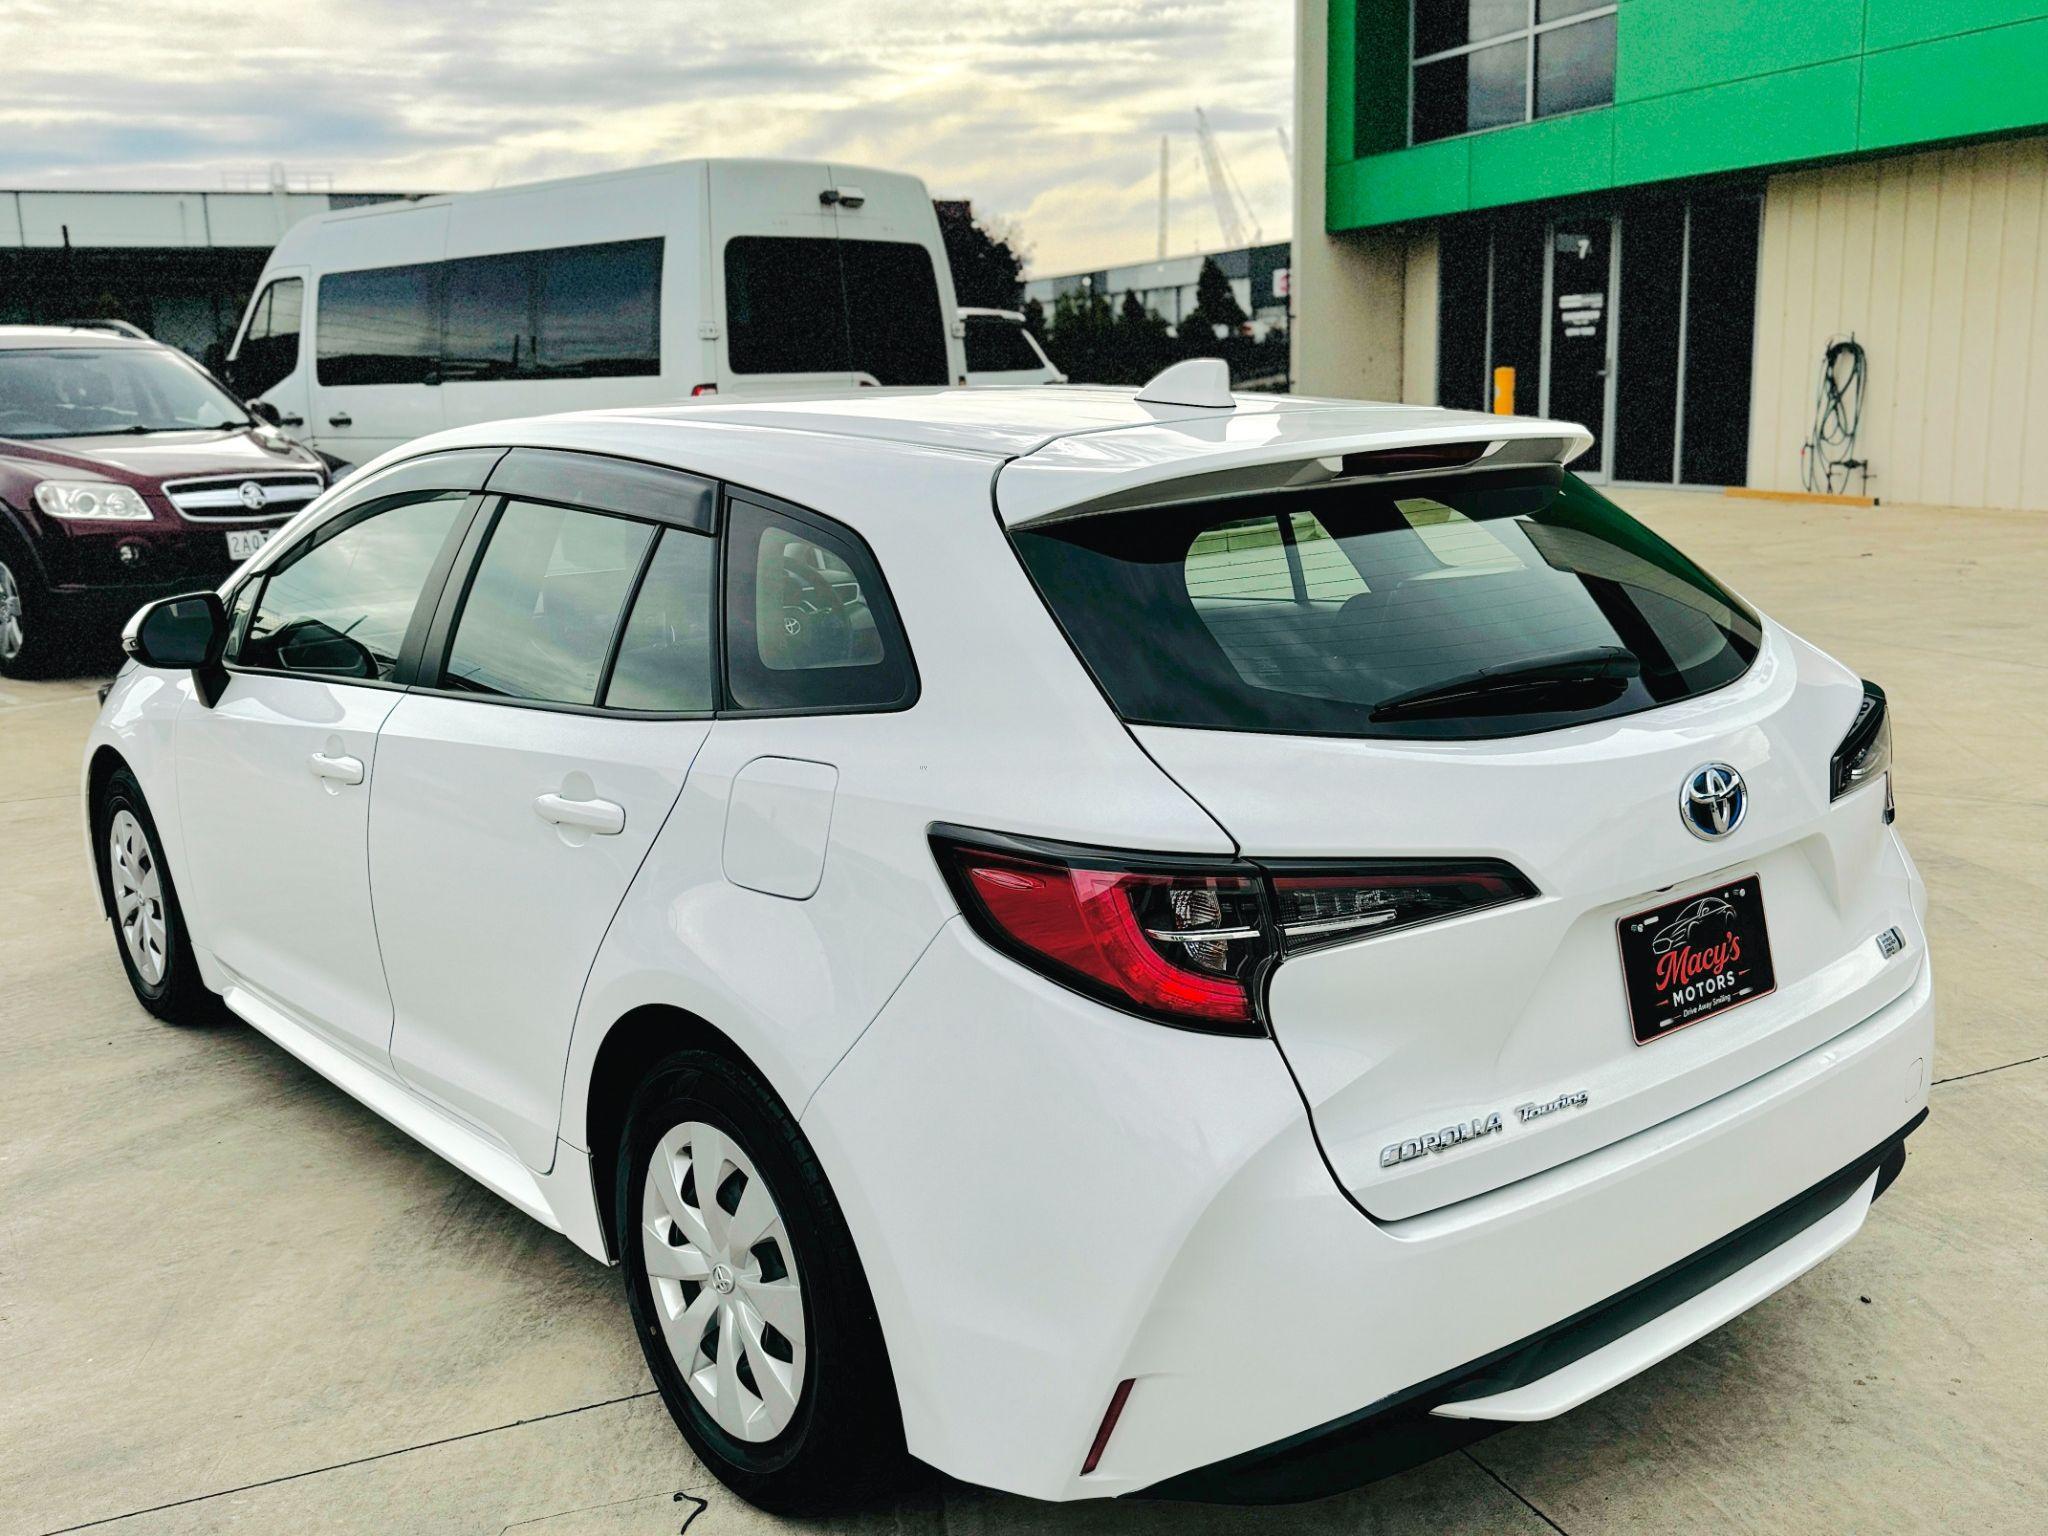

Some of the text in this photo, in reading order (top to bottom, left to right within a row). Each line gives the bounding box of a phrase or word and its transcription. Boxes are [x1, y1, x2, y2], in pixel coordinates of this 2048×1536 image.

[1578, 239, 1590, 259] 7
[1656, 931, 1740, 991] Macy's
[1673, 970, 1735, 1007] MOTORS
[1683, 1006, 1698, 1018] Drive
[1698, 1001, 1713, 1012] Away
[1380, 1089, 1589, 1168] COROLLA Touring
